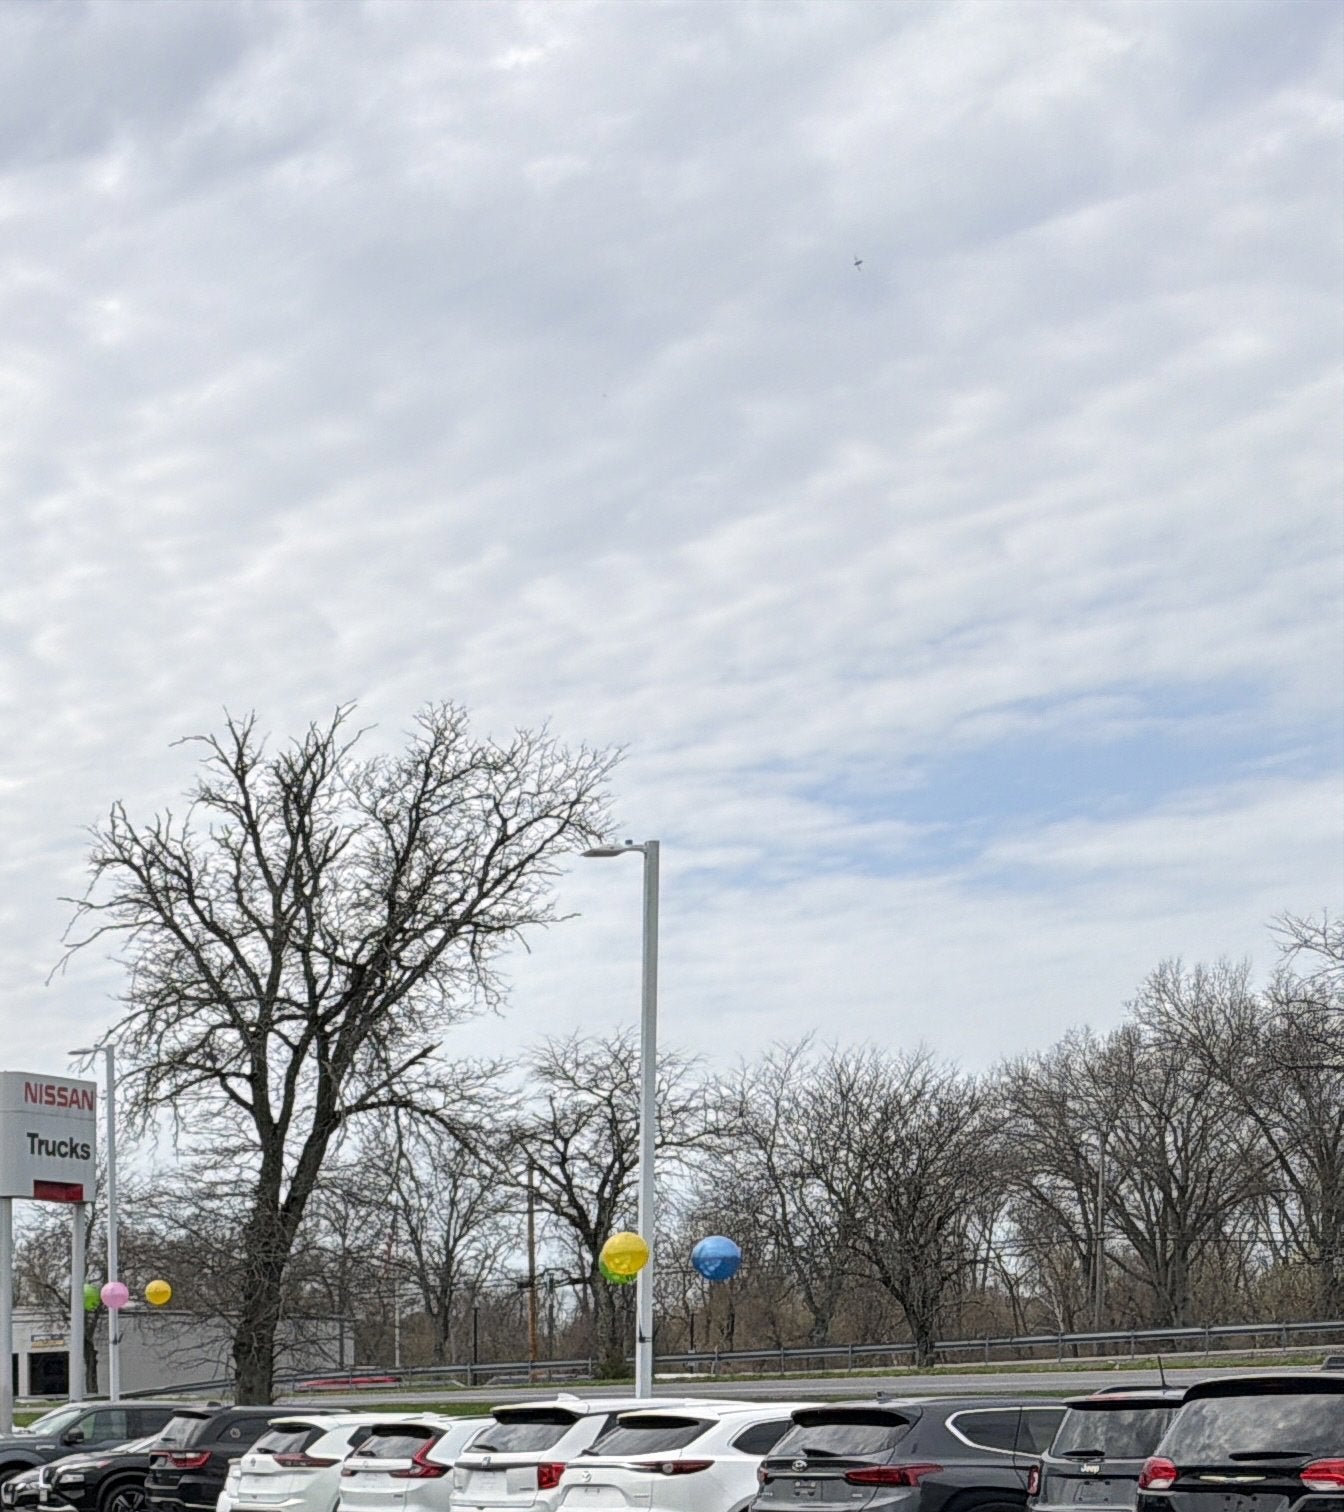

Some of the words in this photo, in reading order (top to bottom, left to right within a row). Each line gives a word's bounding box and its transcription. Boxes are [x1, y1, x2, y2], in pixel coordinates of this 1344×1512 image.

[23, 1081, 94, 1111] NISSAN
[26, 1132, 91, 1161] Trucks
[1080, 1464, 1100, 1473] Jeep
